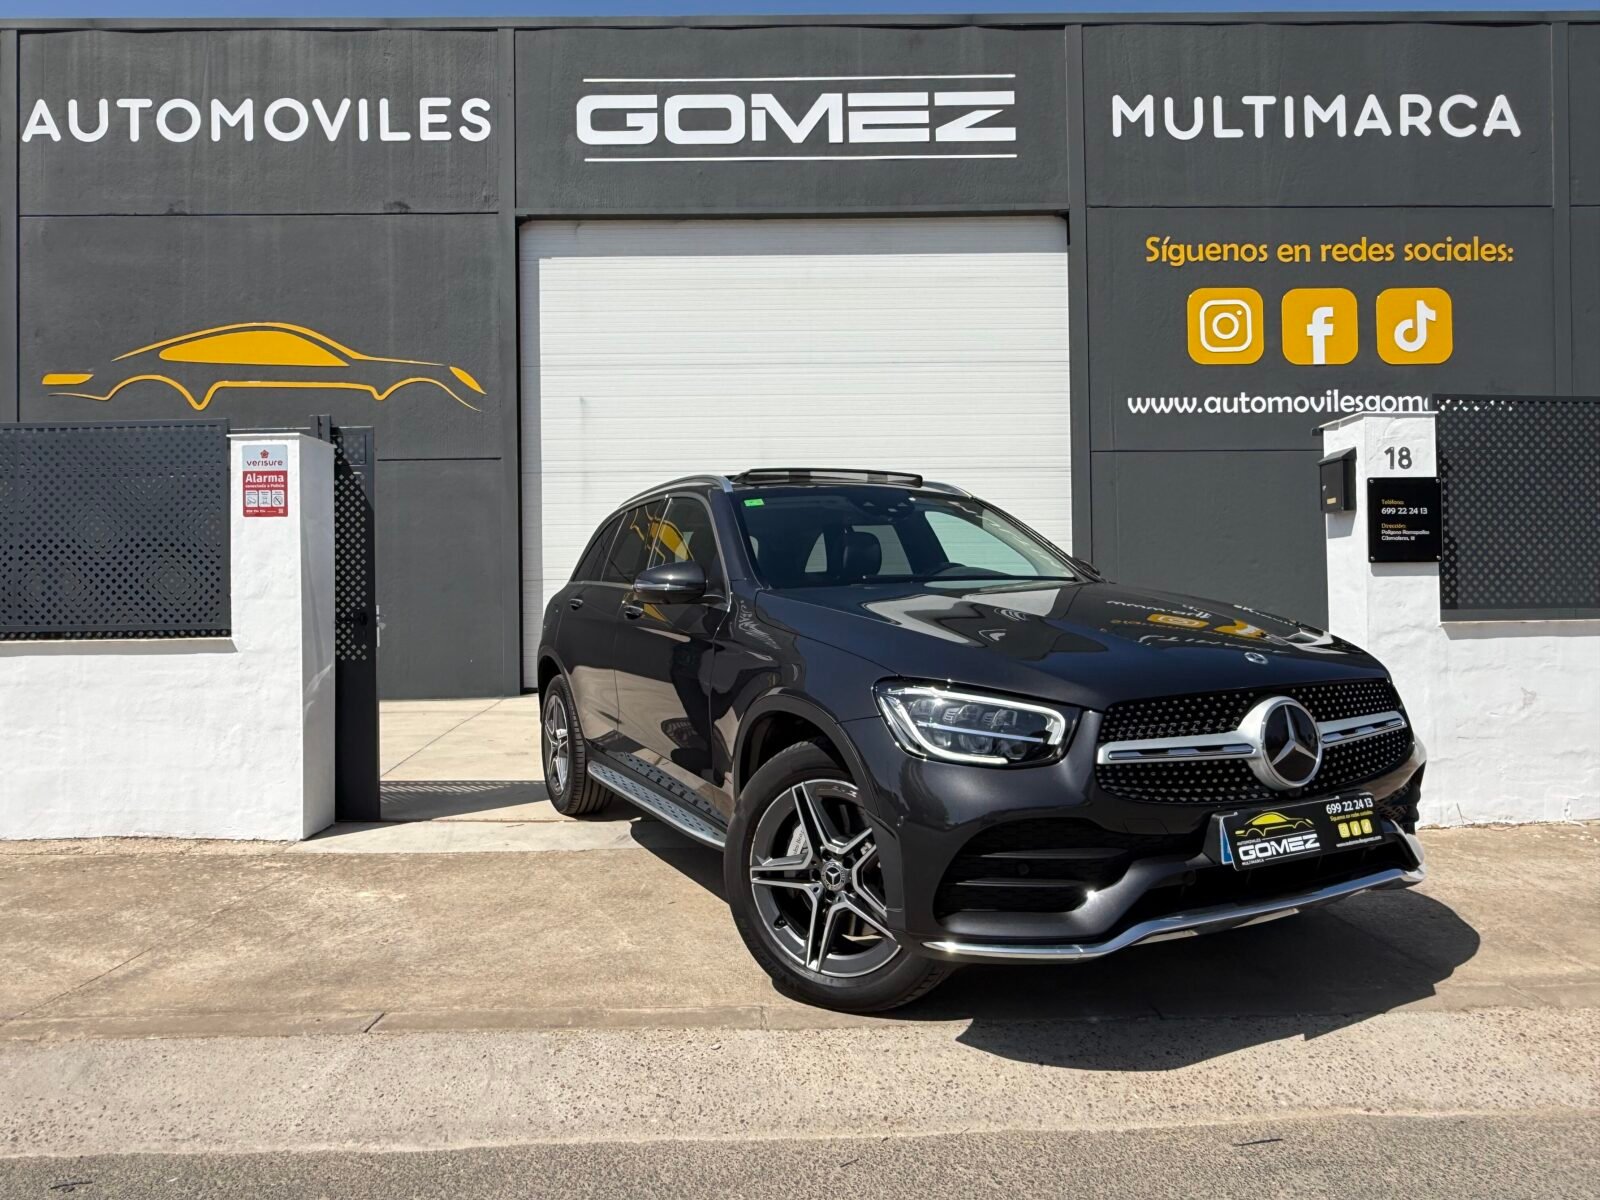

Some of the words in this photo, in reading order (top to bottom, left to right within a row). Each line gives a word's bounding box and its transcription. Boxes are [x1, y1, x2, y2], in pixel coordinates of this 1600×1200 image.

[21, 97, 493, 143] AUTOMOVILES
[576, 90, 1017, 145] GOMEZ
[1111, 93, 1522, 141] MULTIMARCA
[1145, 236, 1269, 267] Síguenos
[1276, 243, 1311, 263] en
[1319, 237, 1395, 263] redes
[1403, 236, 1514, 263] sociales:
[1127, 389, 1429, 414] www.automovilesgom
[1384, 446, 1413, 470] 18
[246, 473, 284, 483] Alarma
[1381, 507, 1396, 515] 699
[1397, 507, 1408, 515] 22
[1408, 507, 1419, 515] 24
[1420, 507, 1428, 515] 13
[1326, 802, 1342, 815] 699
[1342, 800, 1354, 812] 22
[1353, 798, 1364, 810] 24
[1364, 797, 1374, 808] 13
[1238, 833, 1321, 861] GOMEZ
